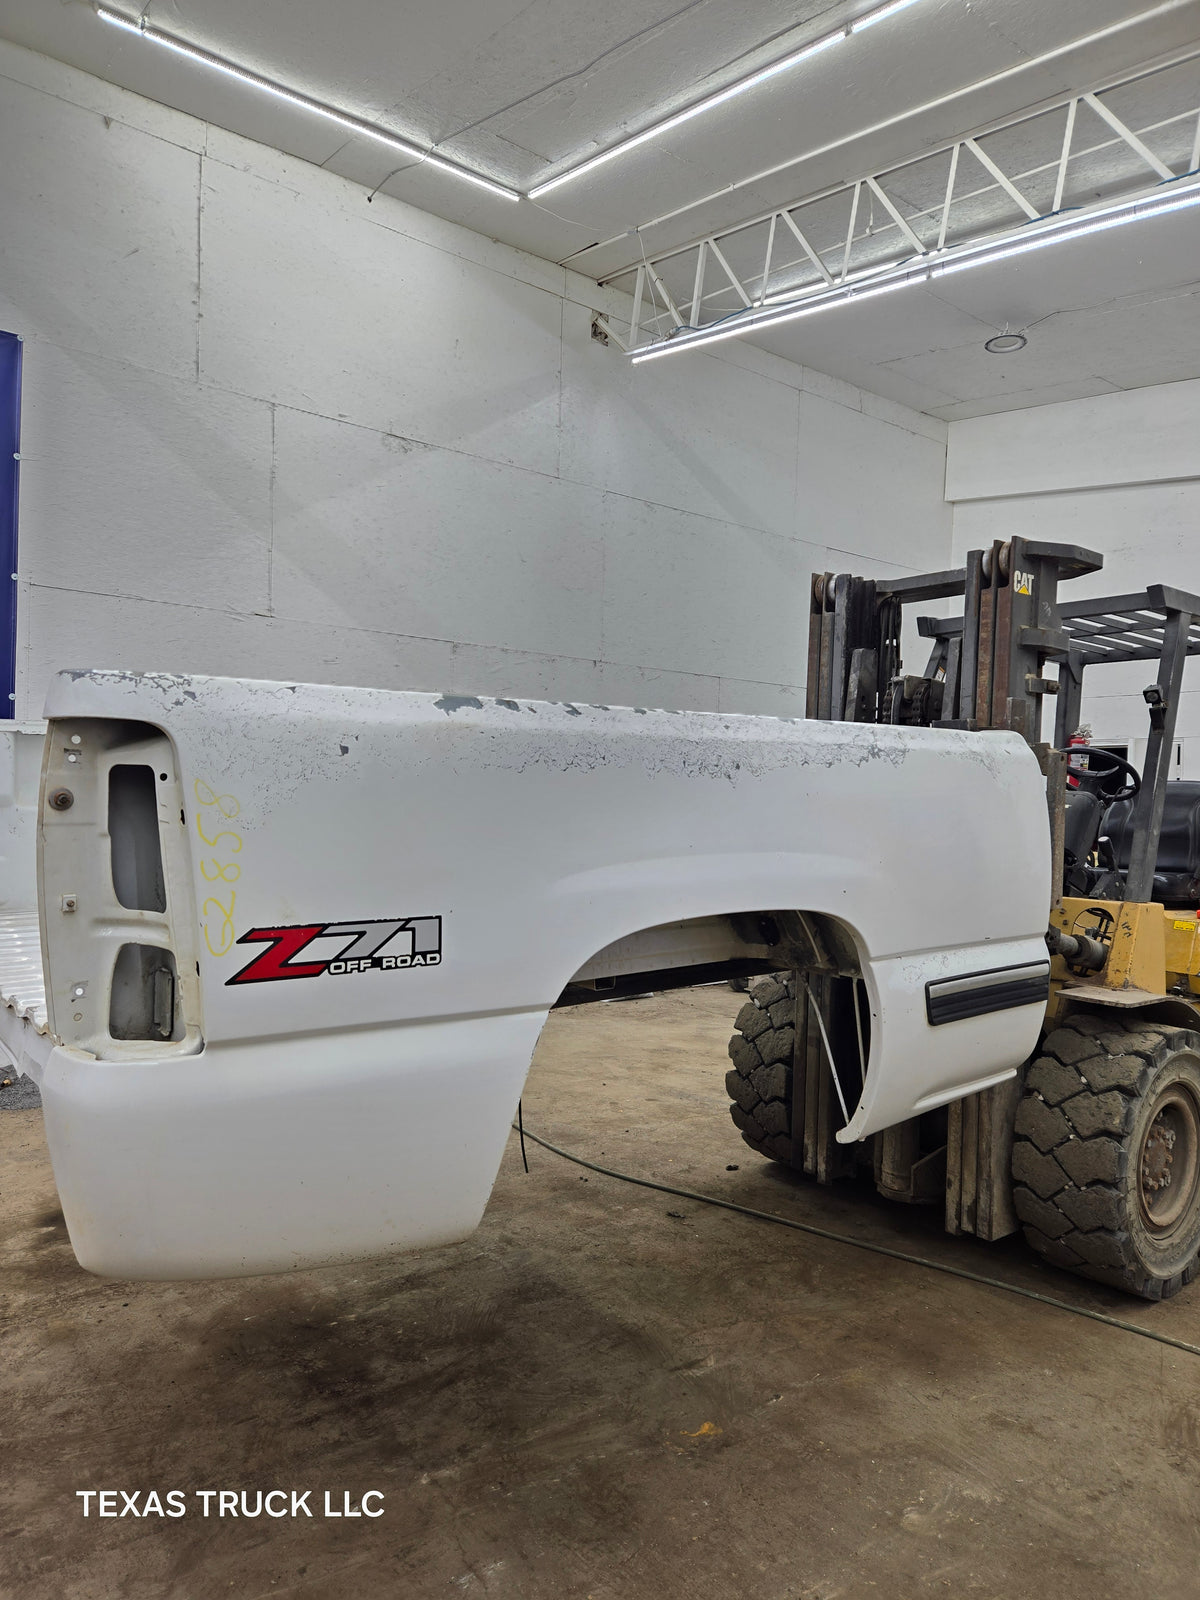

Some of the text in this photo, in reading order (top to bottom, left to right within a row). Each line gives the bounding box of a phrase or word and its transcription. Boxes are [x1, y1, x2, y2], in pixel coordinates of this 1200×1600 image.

[1013, 570, 1034, 596] CAT
[224, 915, 442, 986] Z71
[329, 952, 441, 975] OFF ROAD
